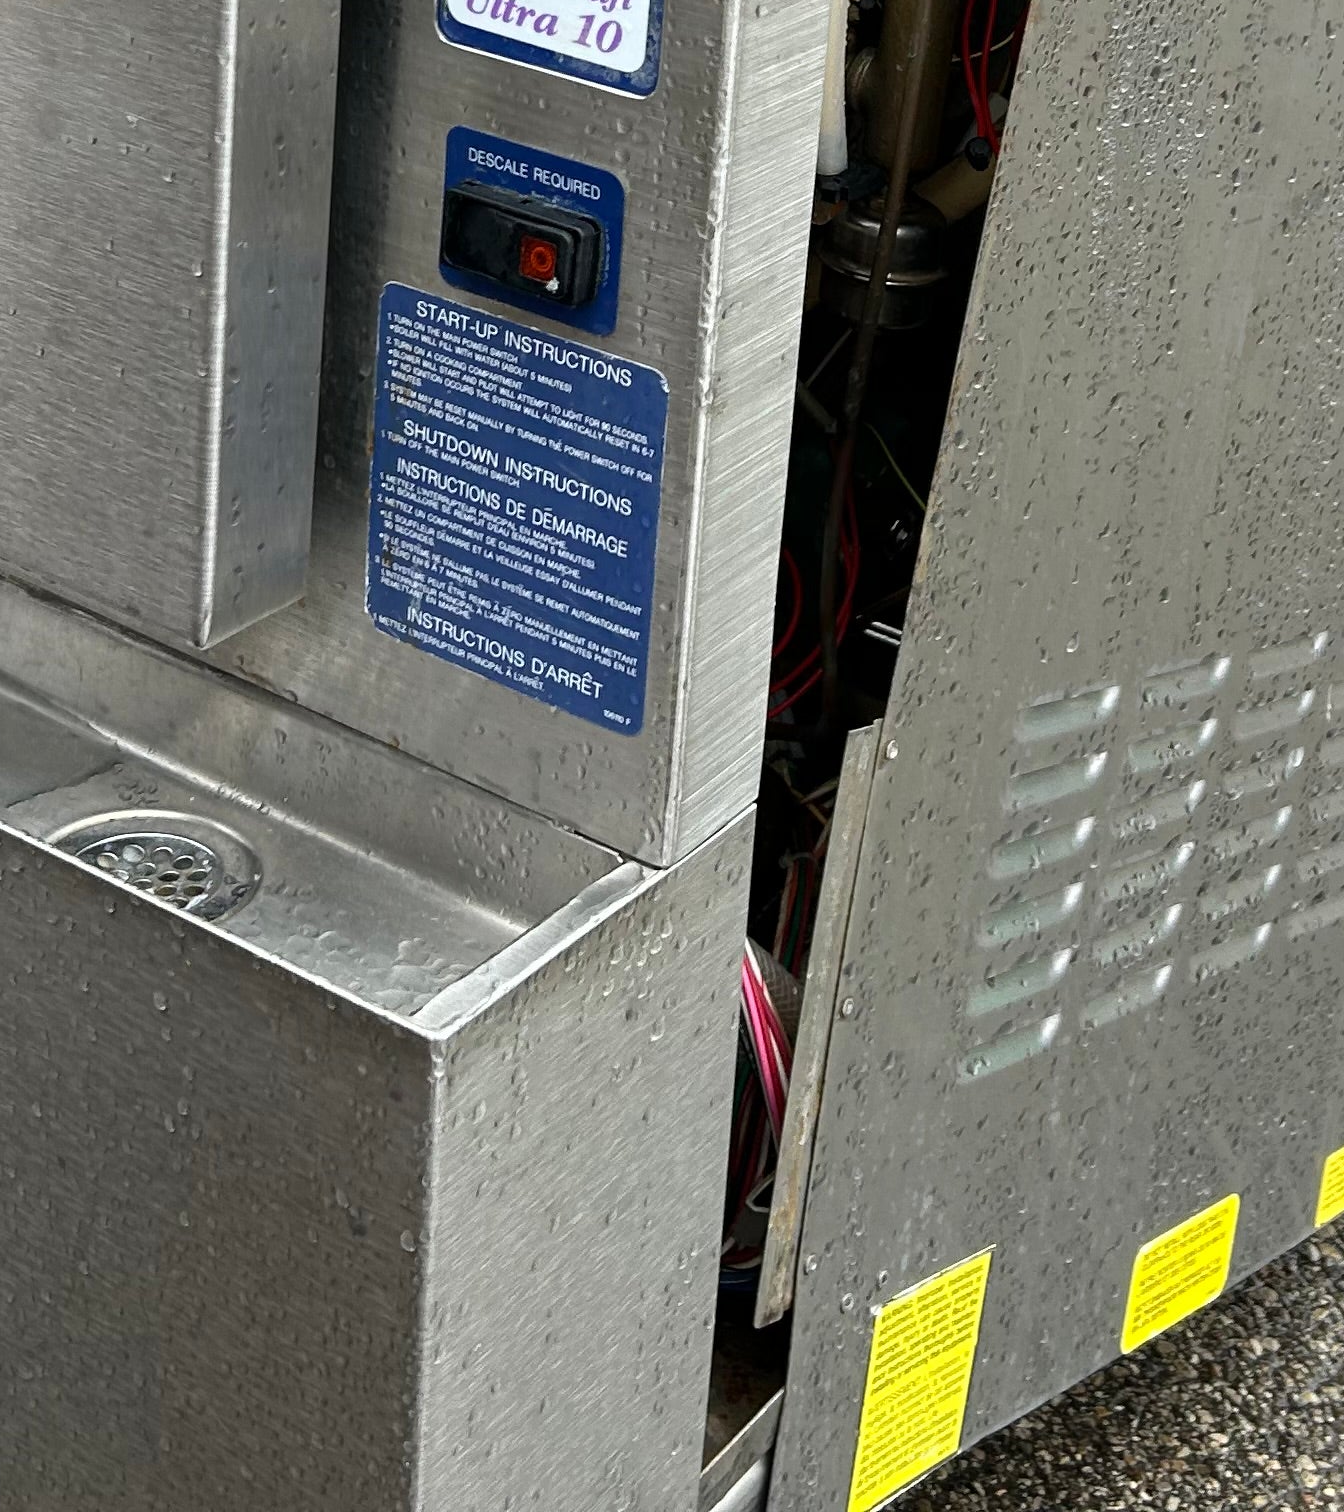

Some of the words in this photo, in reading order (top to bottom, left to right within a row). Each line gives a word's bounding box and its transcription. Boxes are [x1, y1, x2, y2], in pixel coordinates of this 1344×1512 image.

[571, 14, 623, 54] 10
[467, 146, 529, 179] DESCALE
[532, 167, 601, 201] REQUIRED
[415, 298, 498, 343] START-UP
[503, 328, 632, 388] INSTRUCTIONS
[396, 455, 501, 511] INSTRUCTIONS
[505, 496, 527, 521] DE
[531, 506, 629, 559] DÉMARRAGE
[403, 417, 499, 469] SHUTDOWN
[504, 454, 632, 518] INSTRUCTIONS
[406, 604, 525, 669] INSTRUCTIONS
[531, 656, 603, 702] D'ARRÊT
